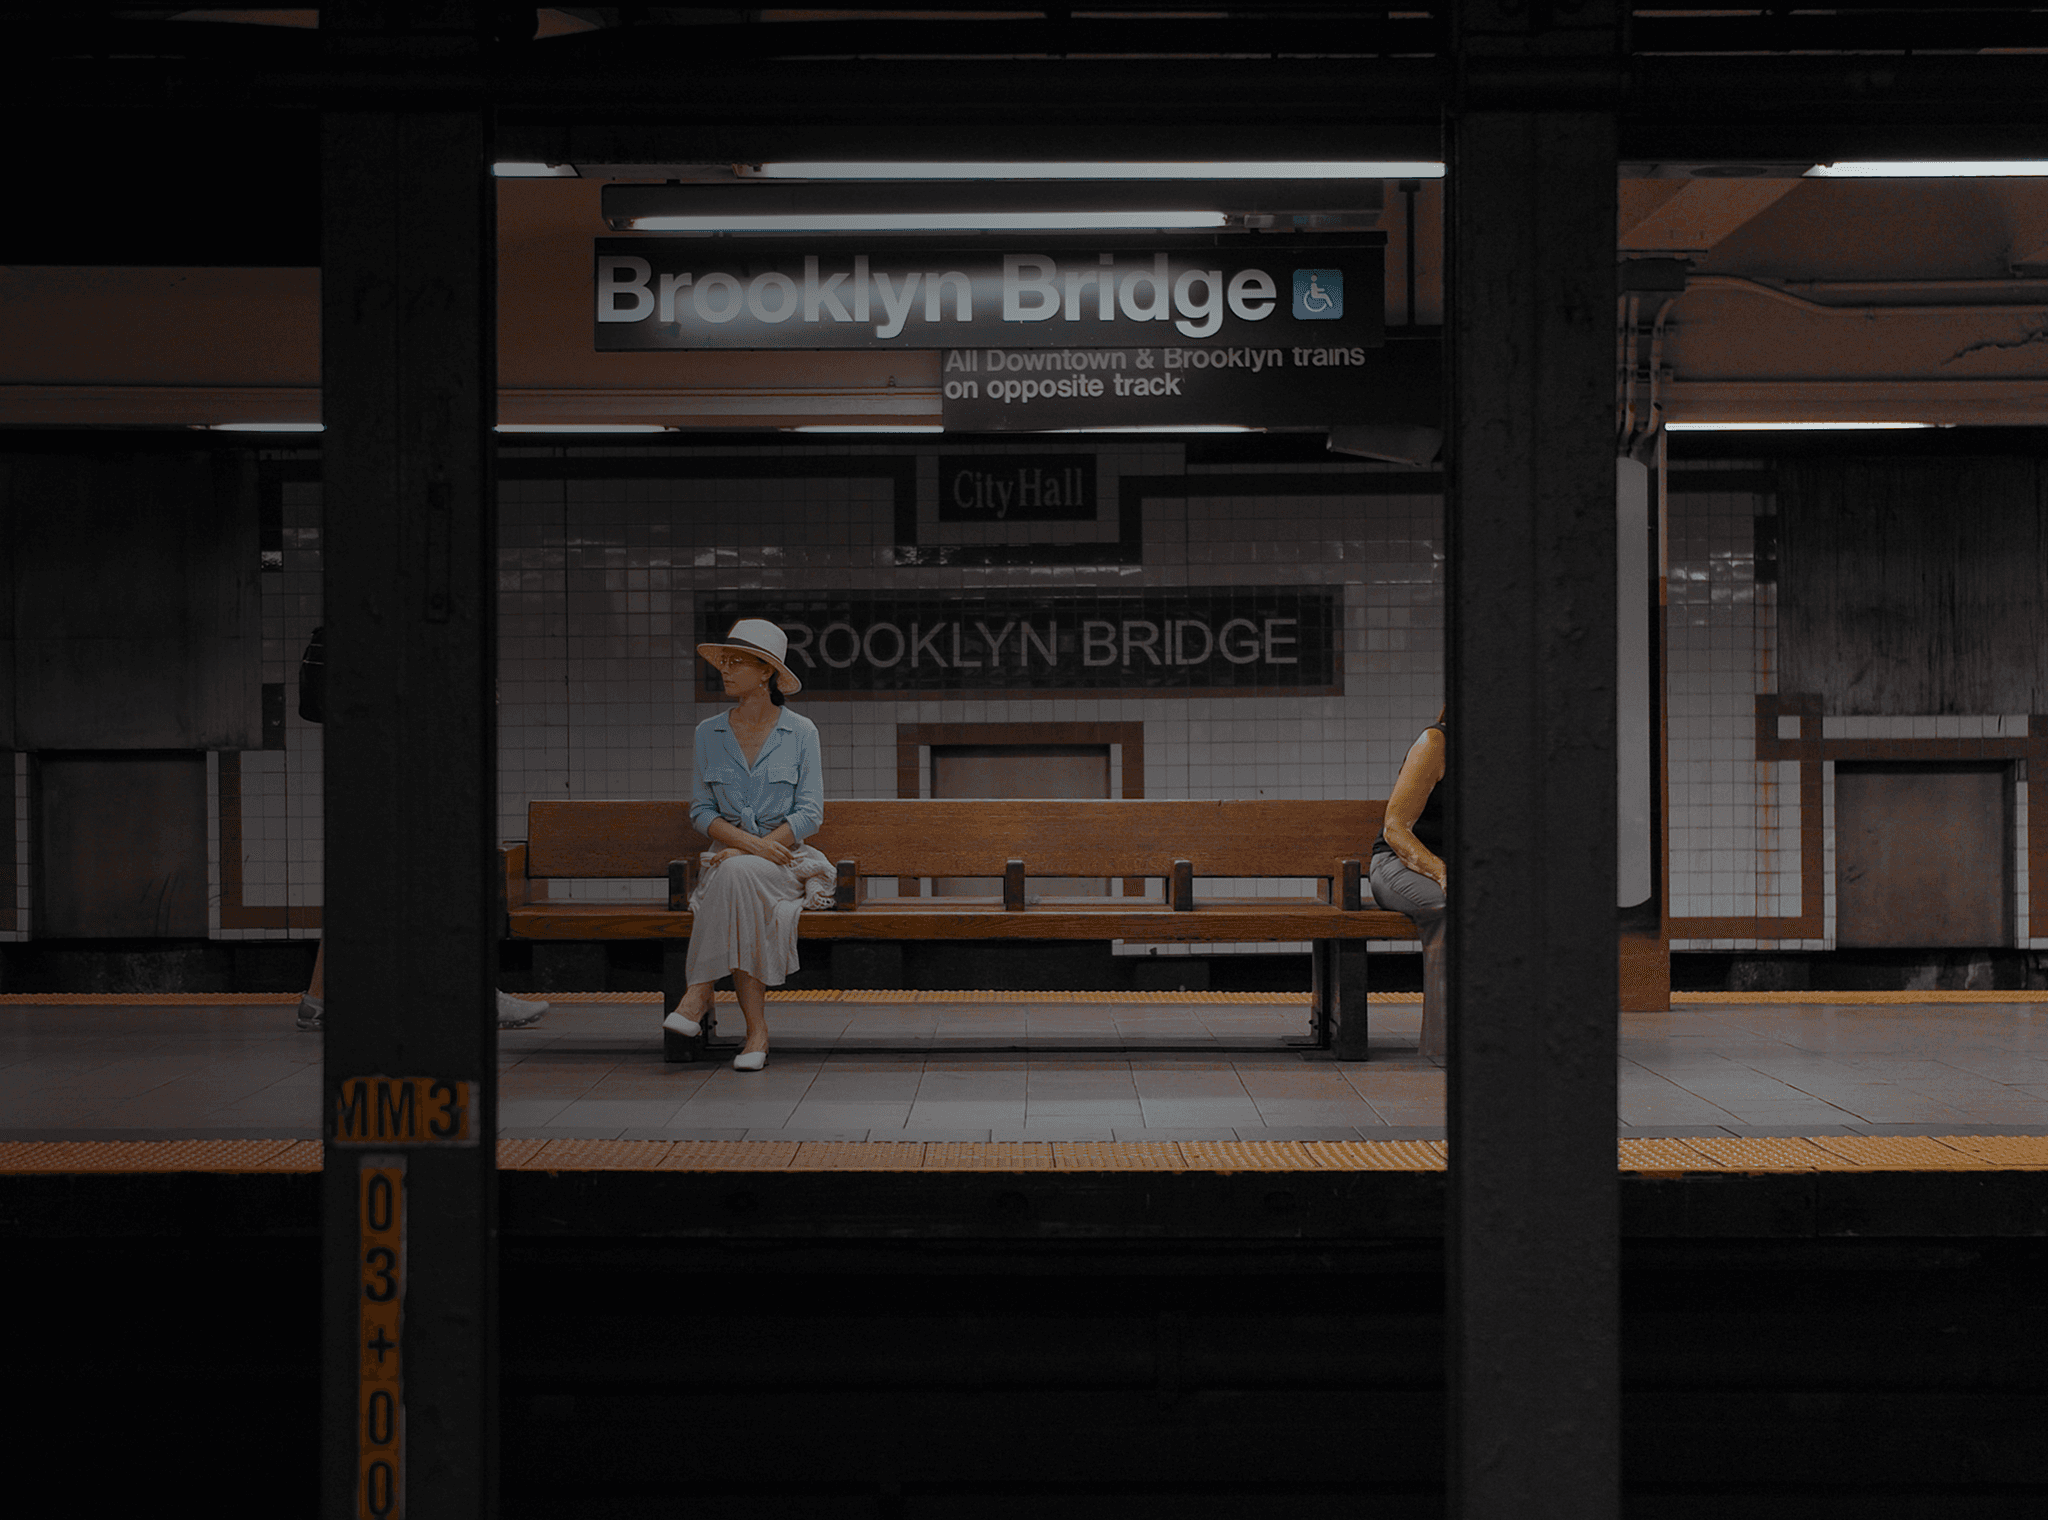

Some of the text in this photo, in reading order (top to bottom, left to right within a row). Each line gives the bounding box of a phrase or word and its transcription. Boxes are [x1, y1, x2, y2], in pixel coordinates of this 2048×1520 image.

[597, 253, 1277, 339] Brooklyn Bridge
[945, 347, 1366, 373] All Downtown & Brooklyn trains
[945, 373, 1182, 403] on opposite track
[953, 467, 1083, 518] City Hall
[779, 618, 1298, 668] ROOKLYN BRIDGE
